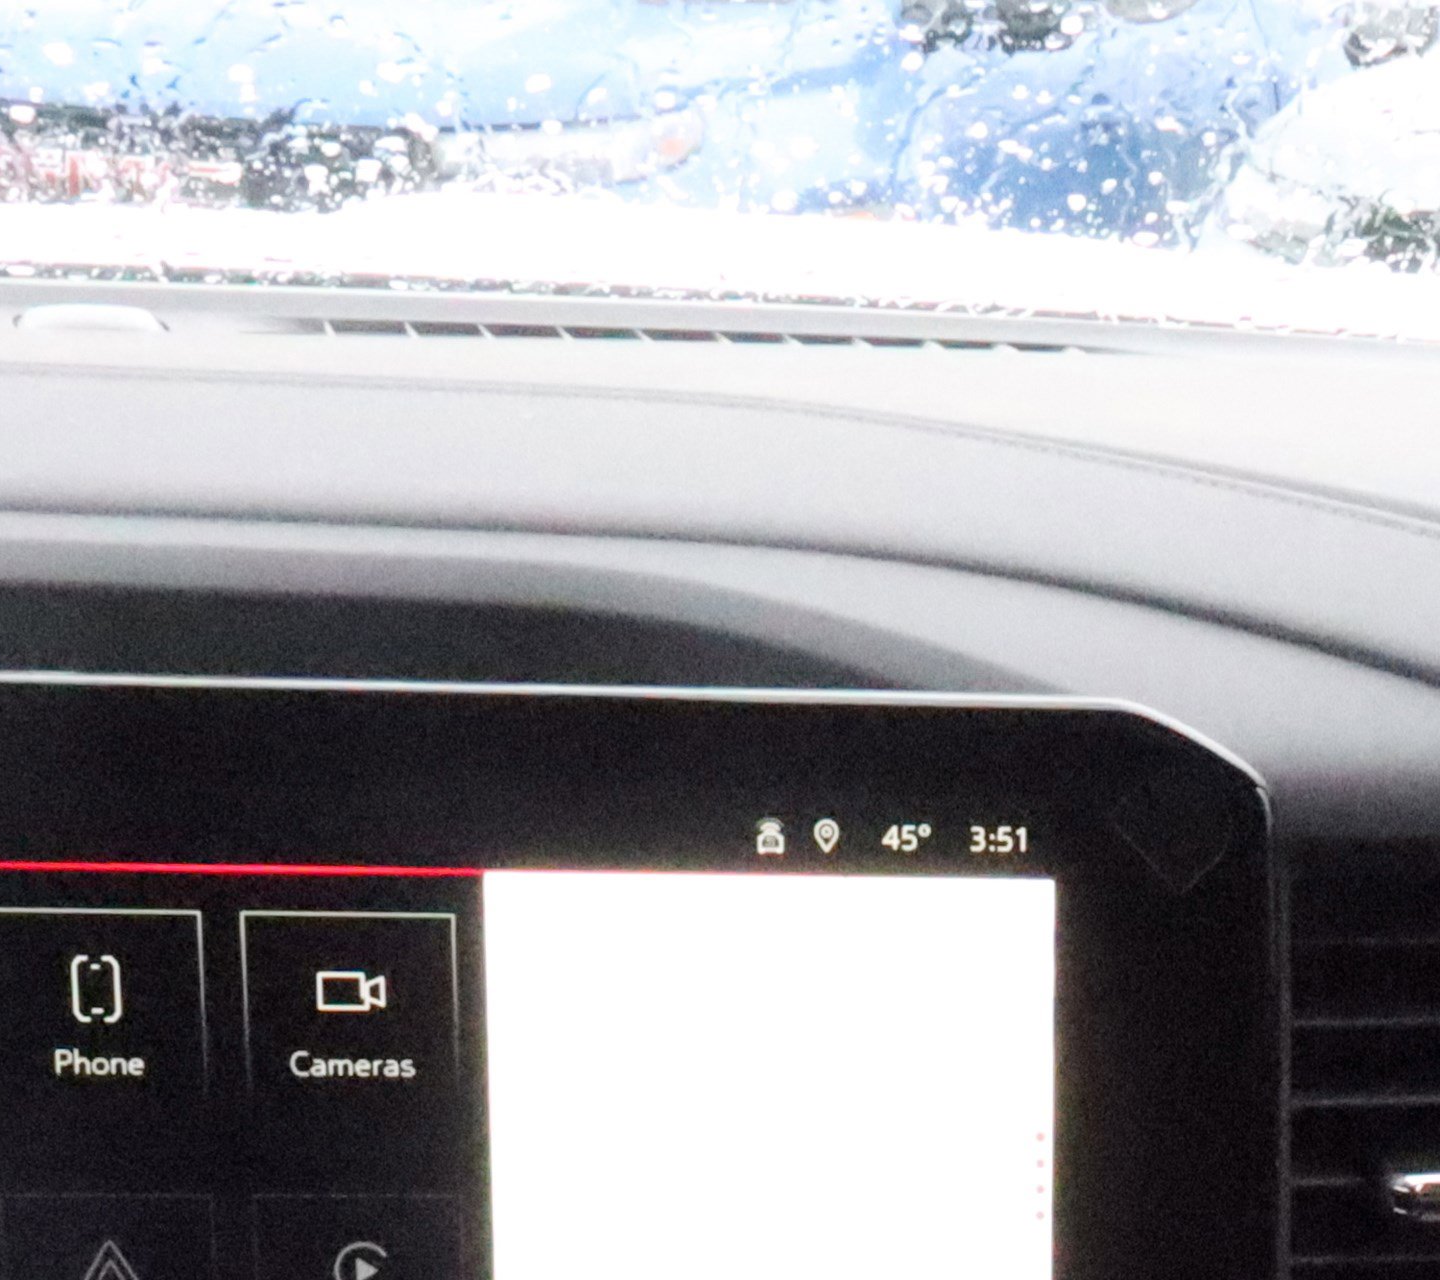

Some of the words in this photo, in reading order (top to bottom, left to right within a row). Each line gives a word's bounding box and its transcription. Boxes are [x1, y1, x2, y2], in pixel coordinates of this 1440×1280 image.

[969, 825, 1029, 854] 3:51
[53, 1048, 146, 1078] Phone
[289, 1051, 416, 1080] Cameras
